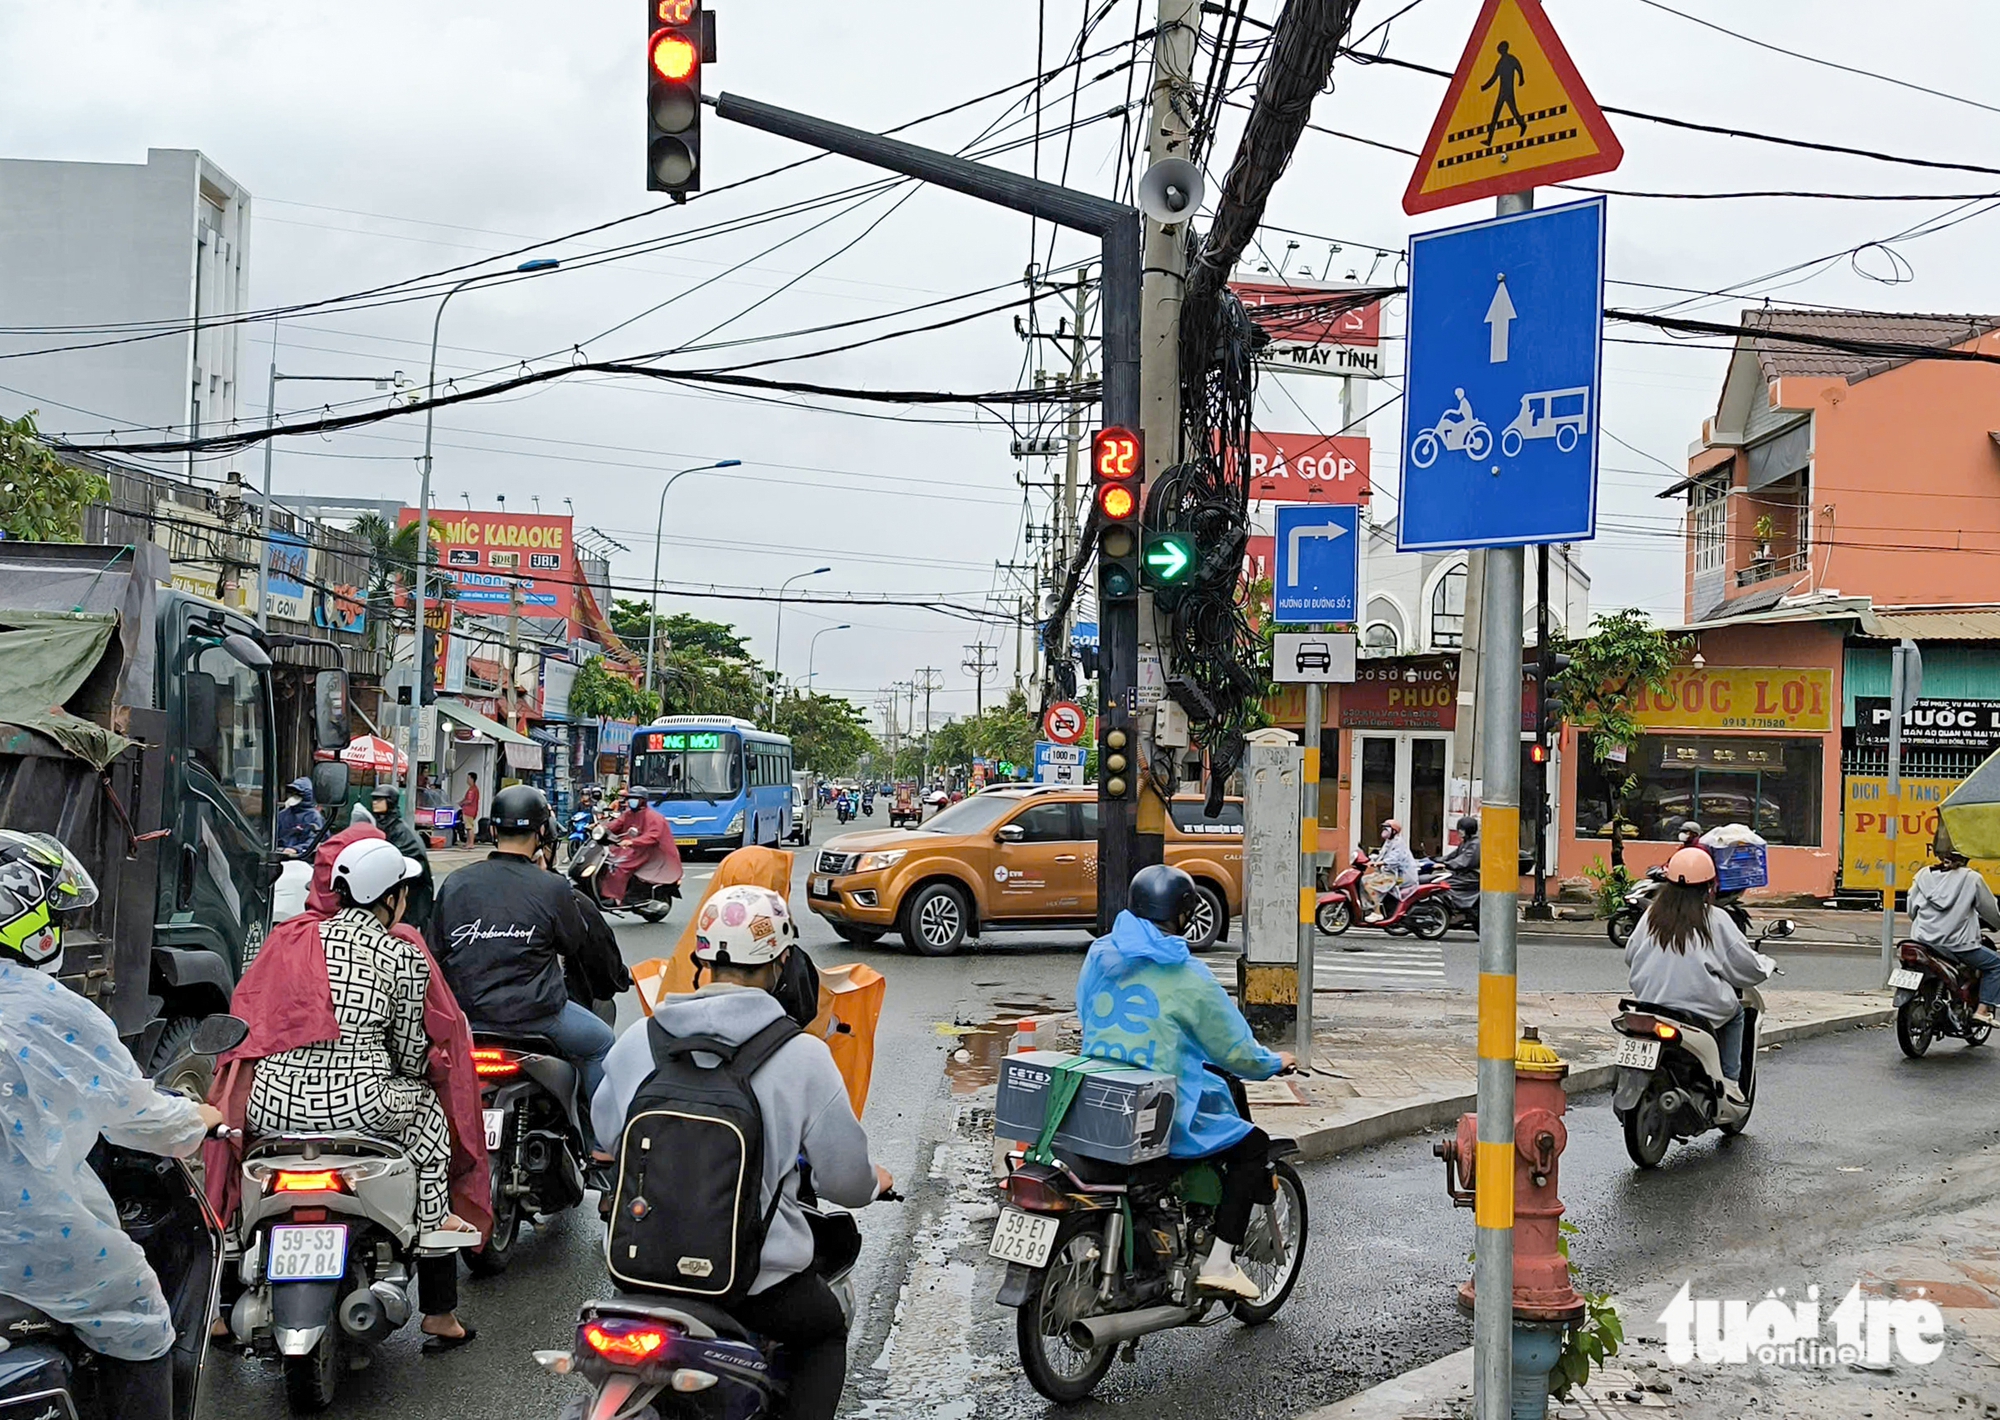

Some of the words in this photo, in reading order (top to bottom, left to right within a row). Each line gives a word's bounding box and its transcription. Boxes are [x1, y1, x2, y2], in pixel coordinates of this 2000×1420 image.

[1337, 348, 1378, 369] TÍNH
[1101, 440, 1133, 473] 22
[1250, 447, 1289, 478] RẢ
[1297, 452, 1357, 481] GÓP
[484, 524, 563, 548] KARAOKE
[533, 554, 558, 568] JBL
[1388, 683, 1451, 707] PHƯỚ
[1754, 675, 1824, 722] LỢI
[649, 734, 663, 750] 93
[1052, 751, 1069, 760] 1000
[1909, 784, 1940, 801] TANG
[1618, 1052, 1654, 1068] 365.32
[282, 1229, 335, 1251] 59-S3
[994, 1234, 1047, 1262] 025.89
[274, 1252, 337, 1276] 687.84
[703, 1349, 752, 1367] EXCITER
